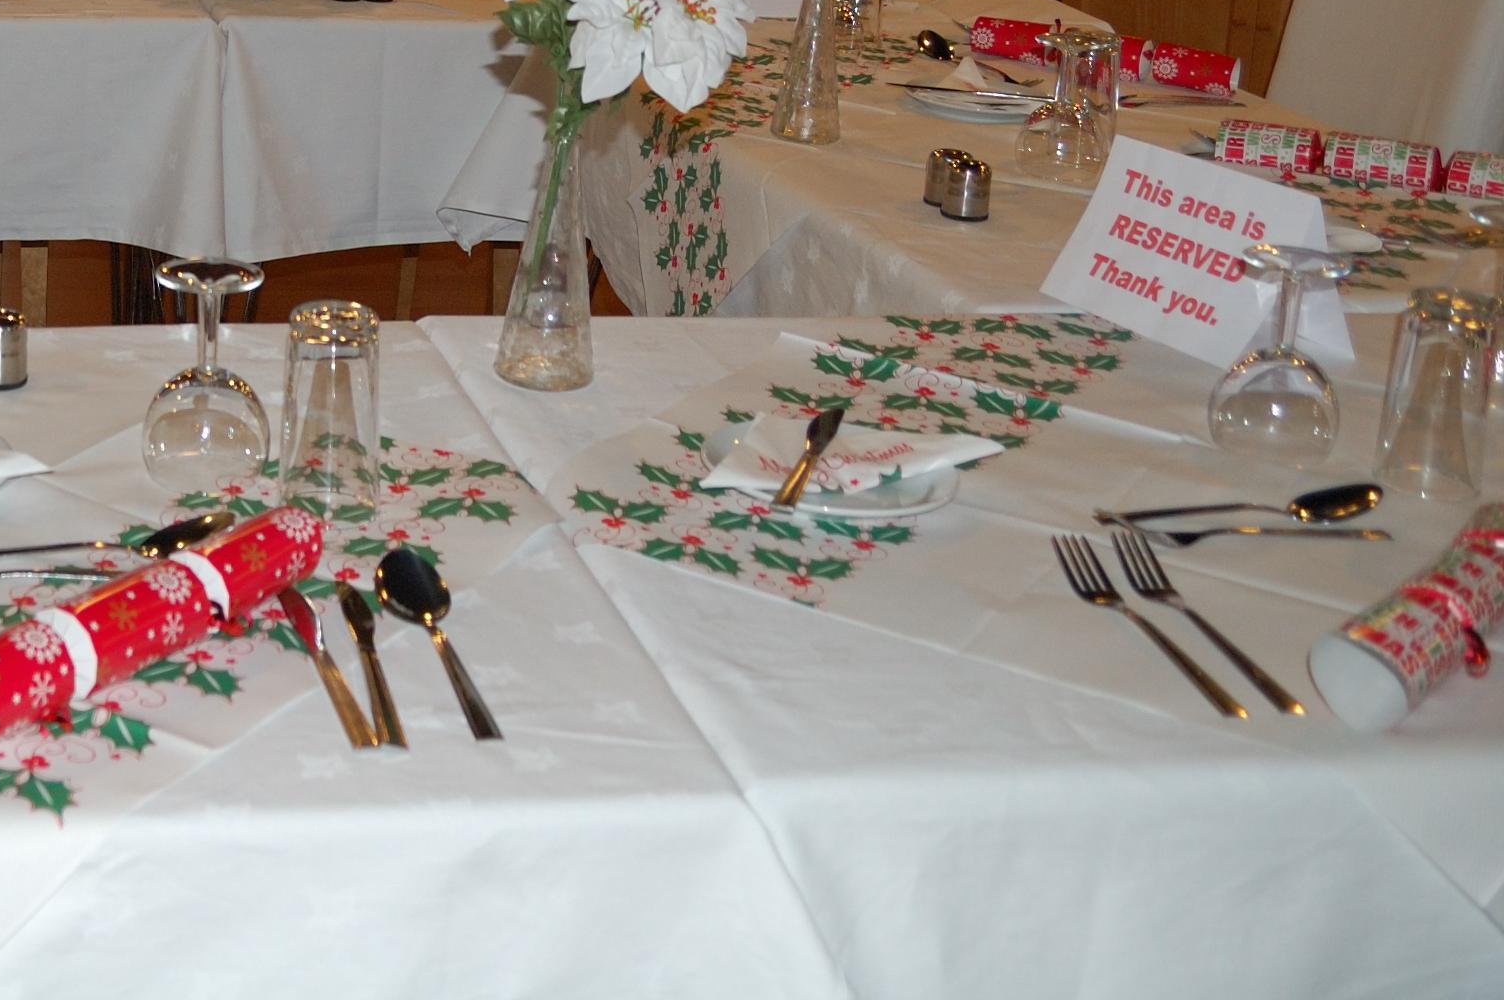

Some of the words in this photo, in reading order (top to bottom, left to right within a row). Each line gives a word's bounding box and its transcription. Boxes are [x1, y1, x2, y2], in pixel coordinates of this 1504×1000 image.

[1123, 169, 1174, 208] This
[1178, 196, 1237, 231] area
[1241, 211, 1267, 241] is
[1108, 214, 1248, 284] RESERVED
[1089, 253, 1164, 303] Thank
[1163, 290, 1218, 326] you.
